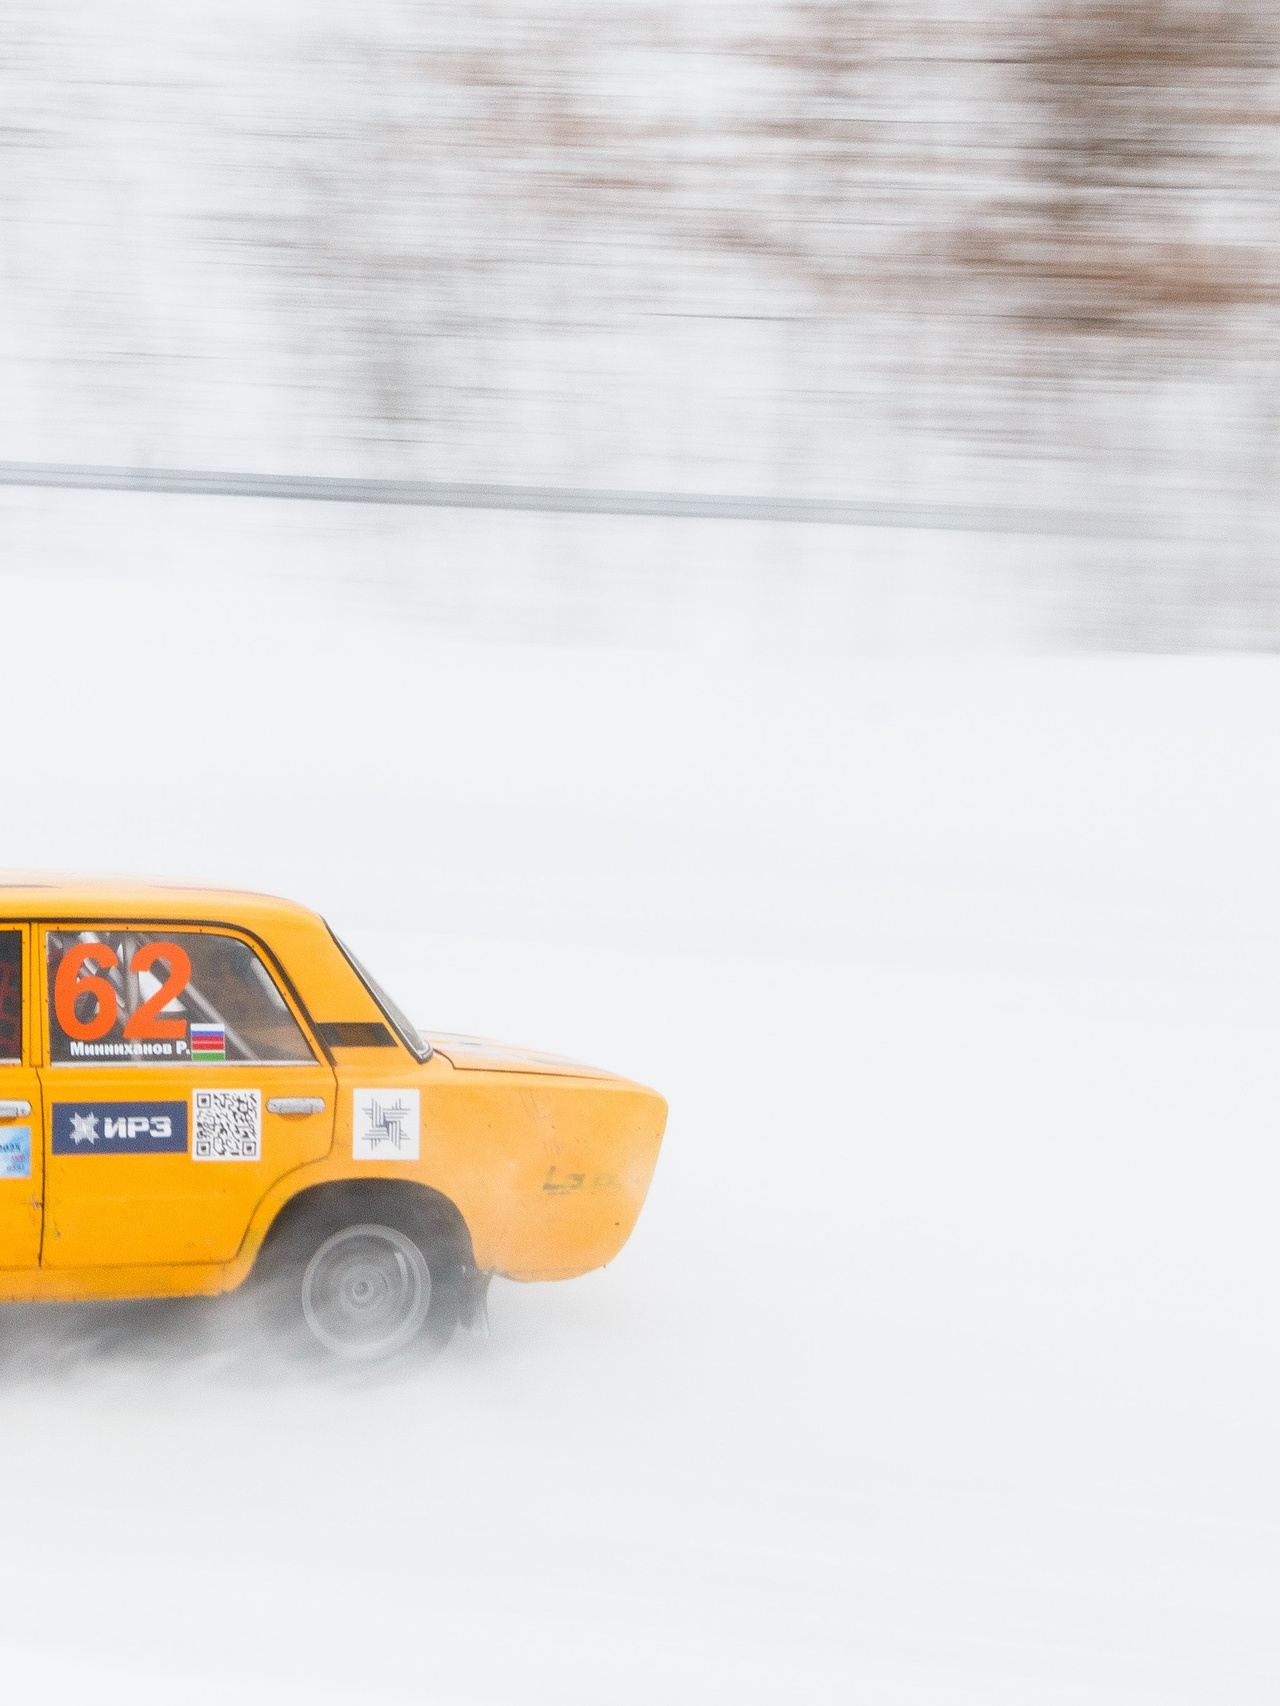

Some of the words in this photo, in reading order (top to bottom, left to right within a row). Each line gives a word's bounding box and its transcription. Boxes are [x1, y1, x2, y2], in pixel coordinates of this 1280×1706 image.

[54, 941, 192, 1041] 62
[70, 1041, 173, 1057] Минниханов
[176, 1041, 191, 1056] Р.
[104, 1115, 172, 1139] ИРЗ
